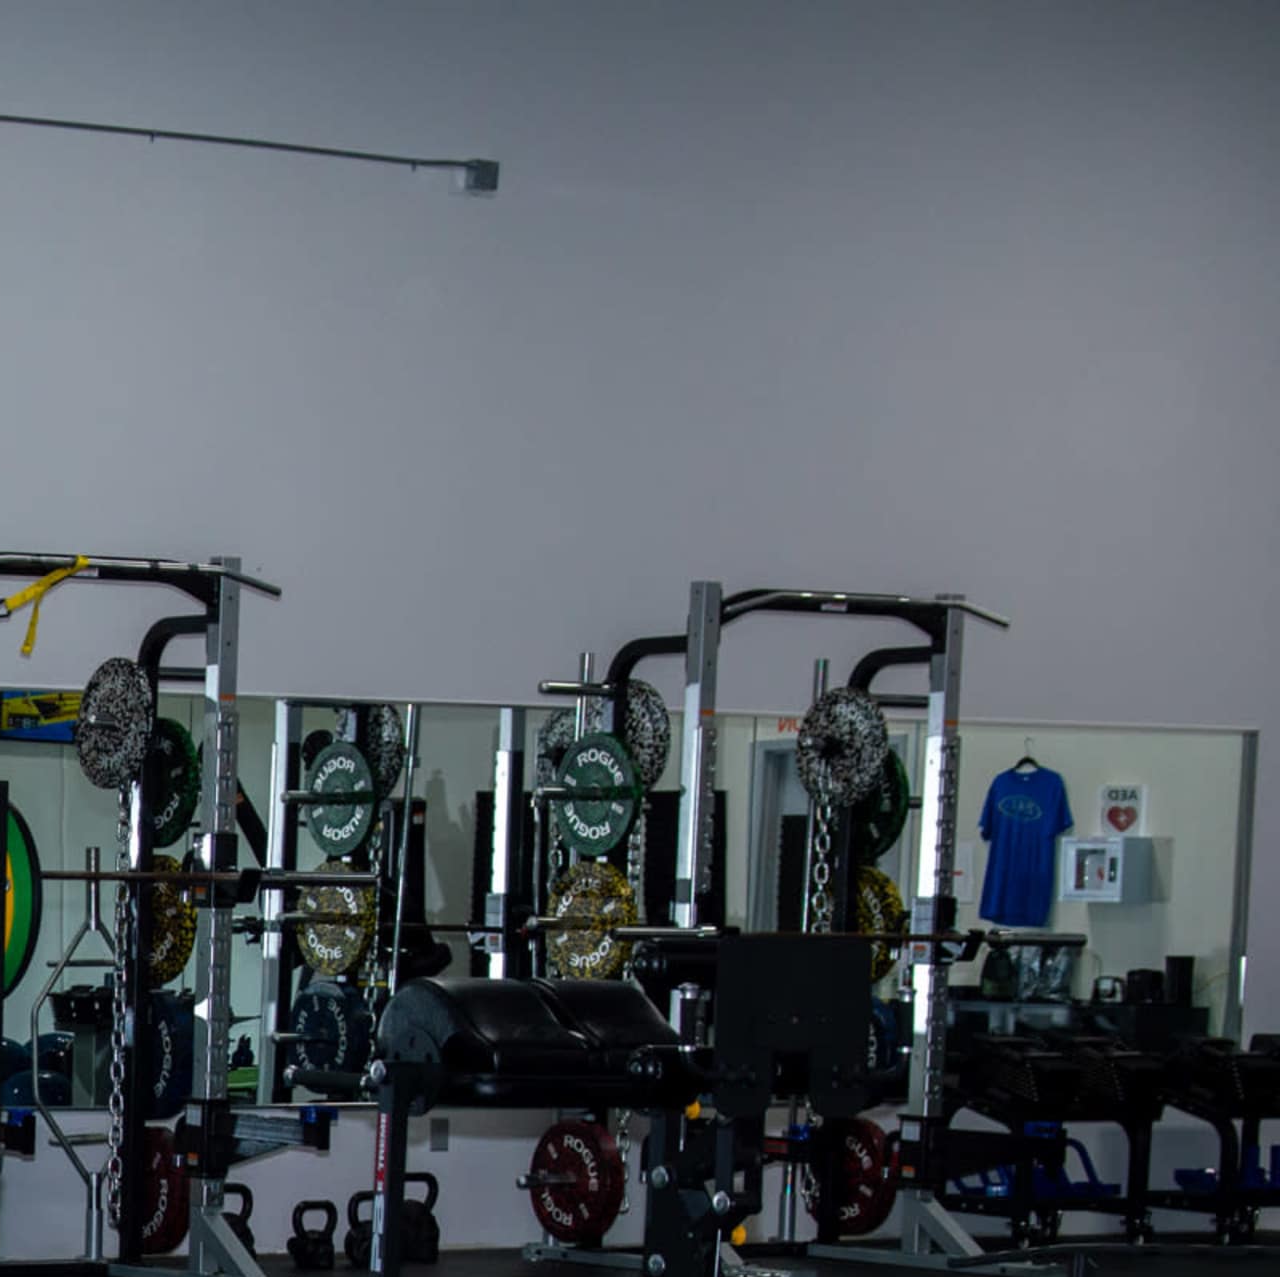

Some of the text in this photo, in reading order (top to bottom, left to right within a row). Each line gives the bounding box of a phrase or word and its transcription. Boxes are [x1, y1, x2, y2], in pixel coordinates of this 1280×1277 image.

[576, 747, 624, 787] ROGUE
[154, 792, 181, 830] ROG
[563, 801, 611, 840] ROGUE
[563, 1133, 600, 1193] ROGUE
